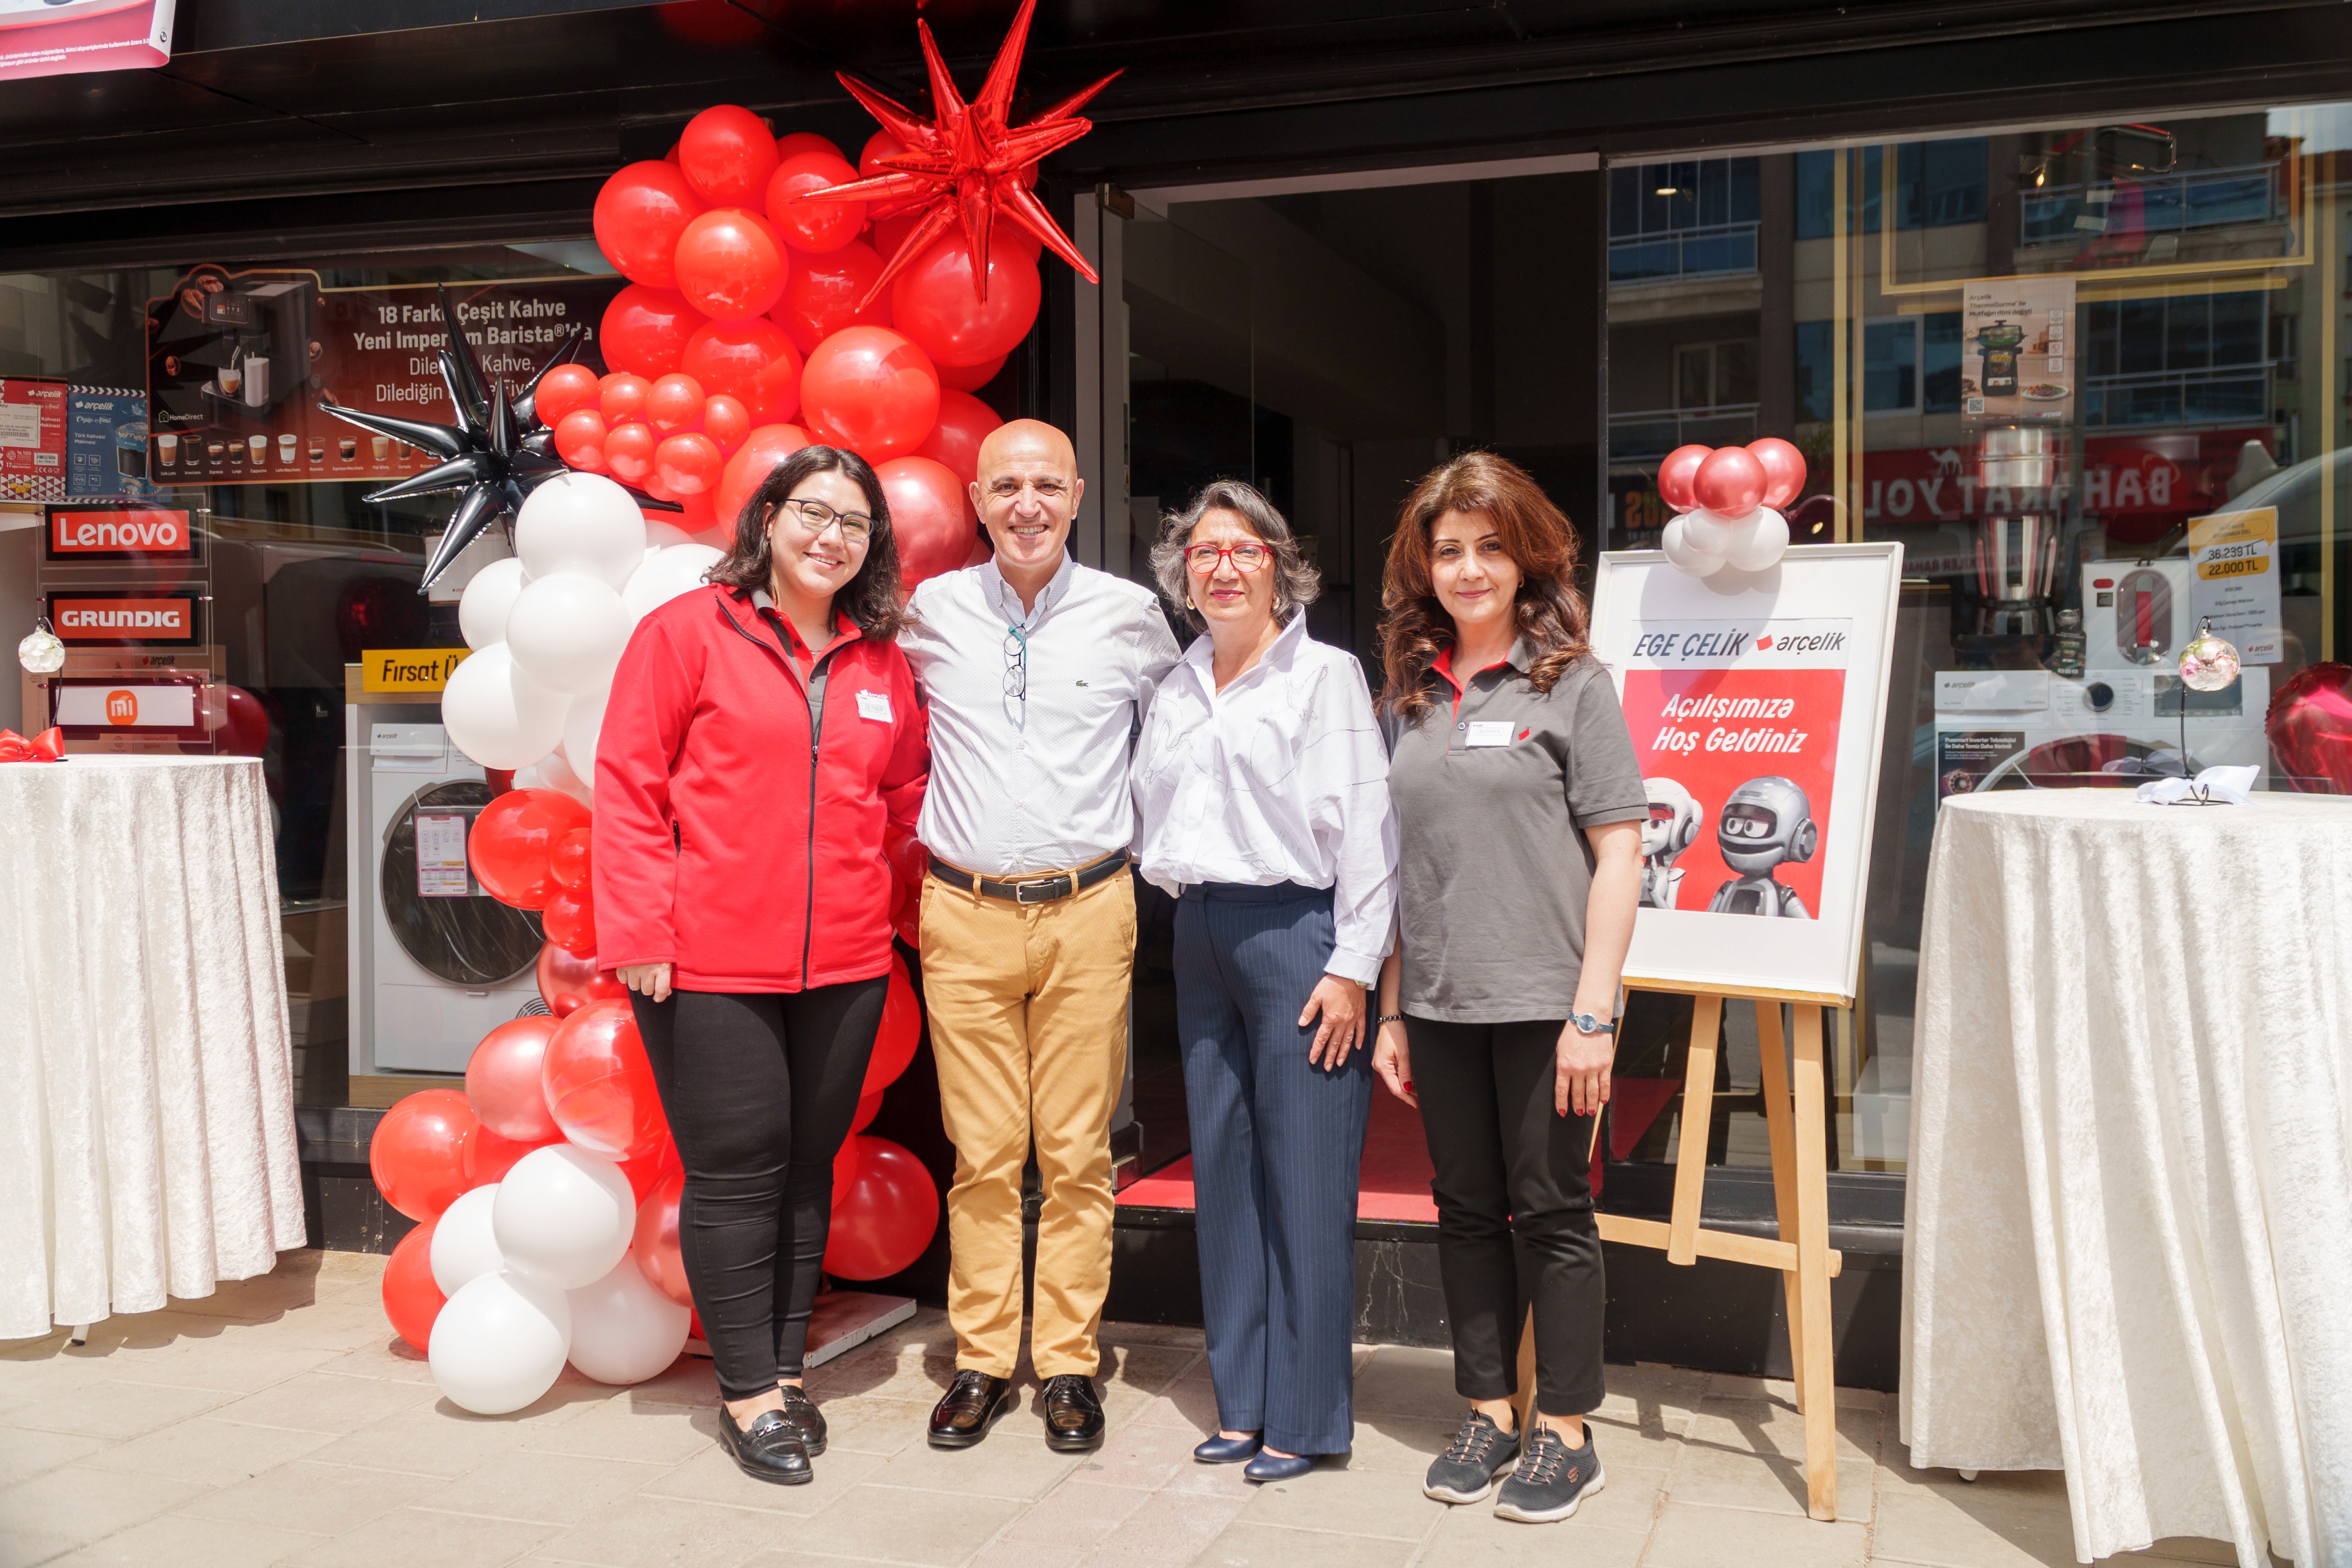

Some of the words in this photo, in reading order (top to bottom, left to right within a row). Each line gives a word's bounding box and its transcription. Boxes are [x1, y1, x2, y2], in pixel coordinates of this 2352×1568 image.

[378, 306, 397, 324] 18
[403, 304, 445, 323] Fark
[457, 302, 504, 326] Çeşit
[510, 299, 566, 317] Kahve
[354, 331, 391, 350] Yeni
[396, 329, 481, 352] Imperm
[482, 353, 535, 373] Kahve,
[376, 383, 442, 404] Dilediğin
[84, 402, 114, 411] arçelik
[60, 518, 177, 546] Lenovo
[2209, 546, 2243, 560] 36.239
[2245, 544, 2257, 556] TL
[2209, 561, 2244, 576] 22.000
[2246, 559, 2258, 572] TL
[61, 610, 180, 627] GRUNDIG
[1633, 633, 1680, 657] EGE
[1681, 628, 1749, 662] ÇELİK
[1776, 632, 1846, 655] arçelik
[2255, 644, 2274, 652] arçelik
[150, 655, 176, 666] arçelik
[383, 659, 439, 682] Fırsat
[1661, 693, 1795, 723] Açılışımıza
[1652, 726, 1699, 756] Hoş
[1705, 727, 1808, 753] Geldiniz
